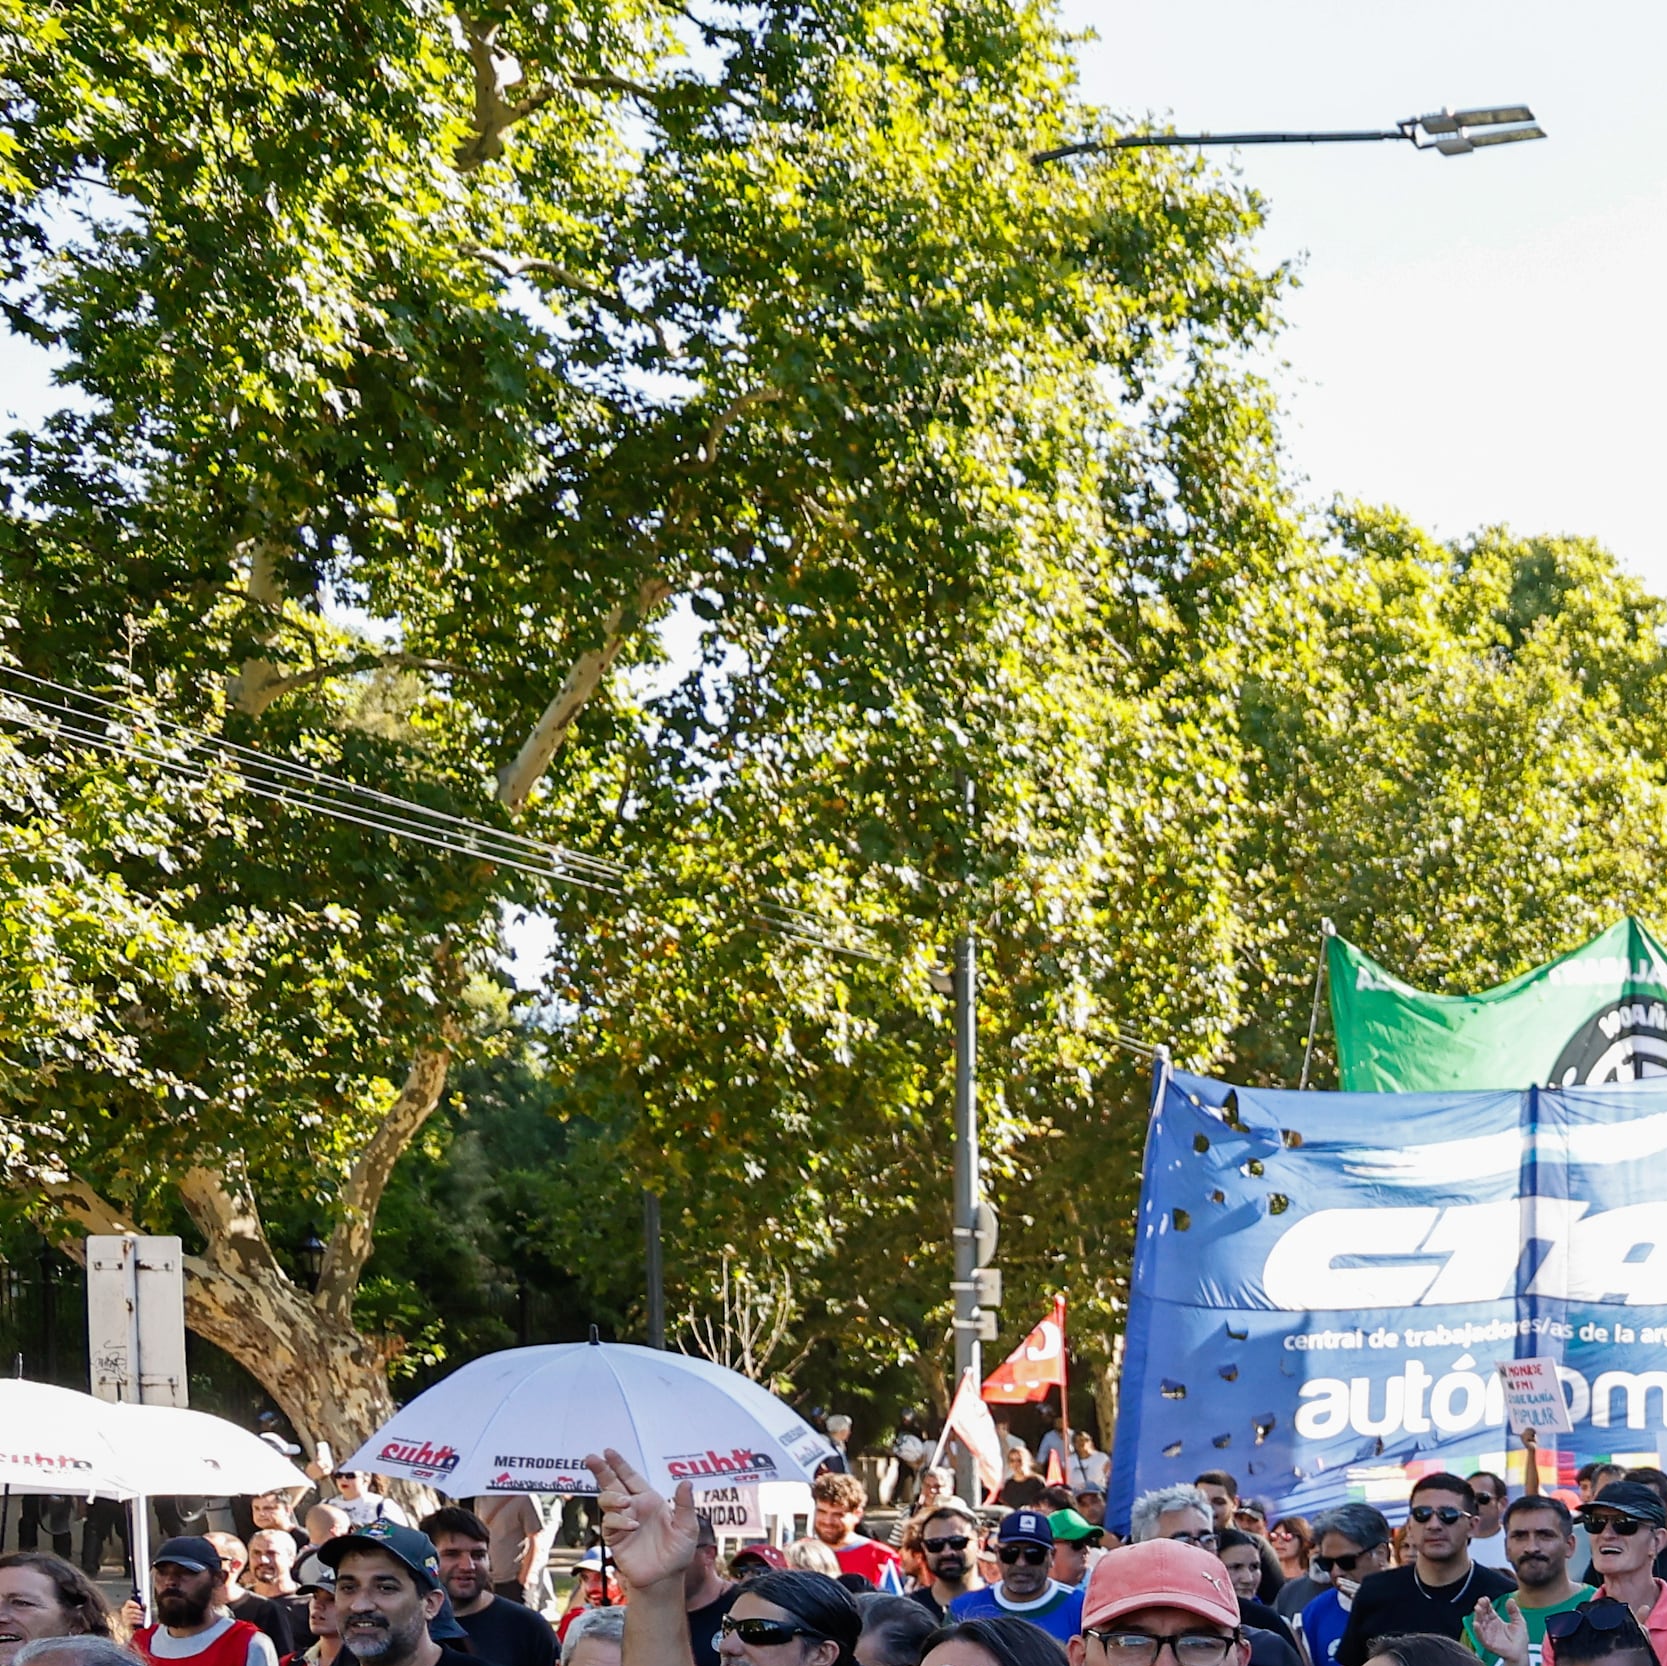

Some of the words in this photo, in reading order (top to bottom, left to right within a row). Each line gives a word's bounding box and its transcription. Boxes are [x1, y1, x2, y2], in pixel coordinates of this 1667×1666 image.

[1283, 1330, 1362, 1351] central
[1369, 1327, 1399, 1349] de
[1579, 1320, 1608, 1343] de
[1614, 1322, 1635, 1343] la
